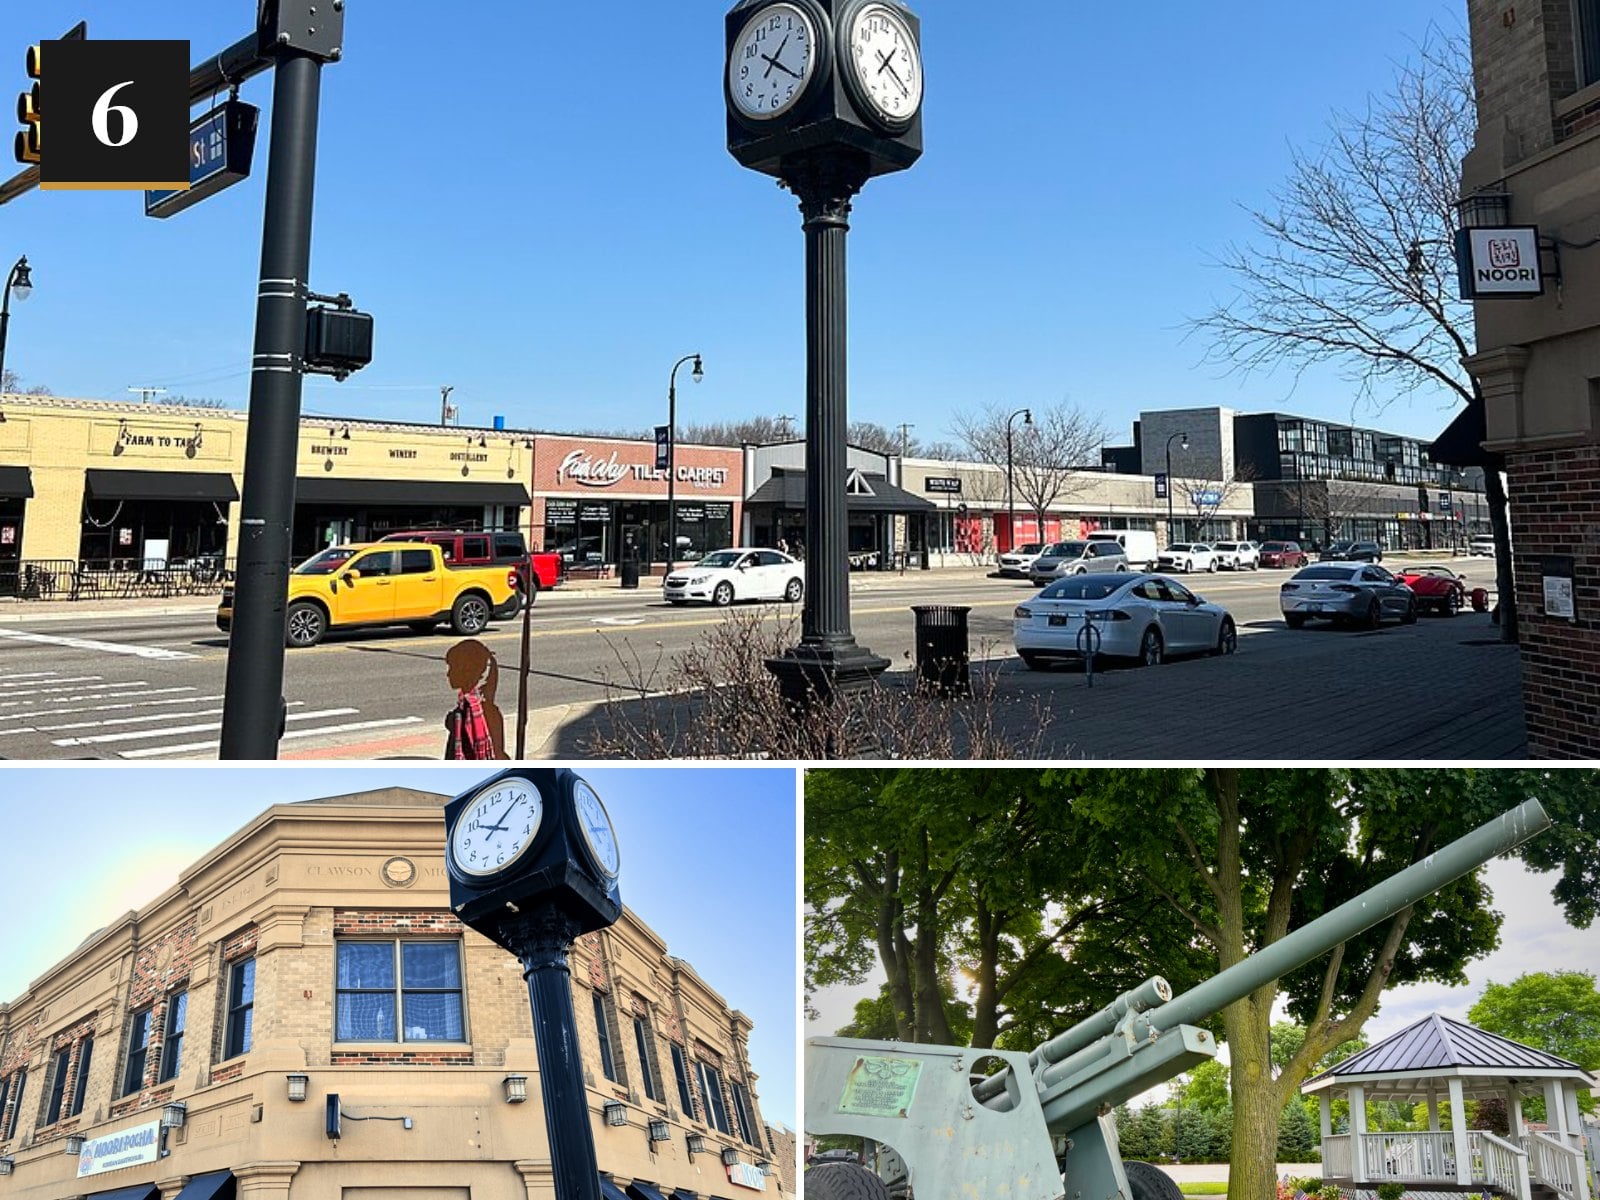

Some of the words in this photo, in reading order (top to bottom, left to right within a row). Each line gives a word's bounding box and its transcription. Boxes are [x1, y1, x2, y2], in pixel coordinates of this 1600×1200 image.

[768, 15, 782, 31] 12
[786, 17, 792, 31] 1
[756, 26, 766, 42] 11
[797, 26, 804, 40] 2
[745, 43, 757, 59] 10
[741, 65, 749, 80] 9
[745, 82, 754, 97] 8
[786, 84, 793, 100] 5
[757, 94, 765, 108] 7
[771, 93, 779, 108] 6
[193, 138, 206, 168] St
[1477, 268, 1536, 282] NOORI
[125, 434, 154, 446] FARM
[157, 436, 171, 447] TO
[311, 444, 348, 456] BREWERY
[388, 449, 417, 459] WINERY
[631, 463, 661, 481] TILE
[676, 467, 729, 483] CARPET
[490, 792, 502, 807] 12
[508, 790, 515, 802] 1
[519, 793, 527, 806] 2
[477, 804, 488, 818] 11
[529, 806, 535, 819] 3
[467, 819, 479, 833] 10
[523, 824, 531, 836] 4
[464, 838, 471, 850] 9
[512, 840, 520, 855] 5
[469, 850, 477, 863] 8
[482, 855, 489, 868] 7
[496, 852, 504, 865] 6
[306, 865, 373, 876] CLAWSON
